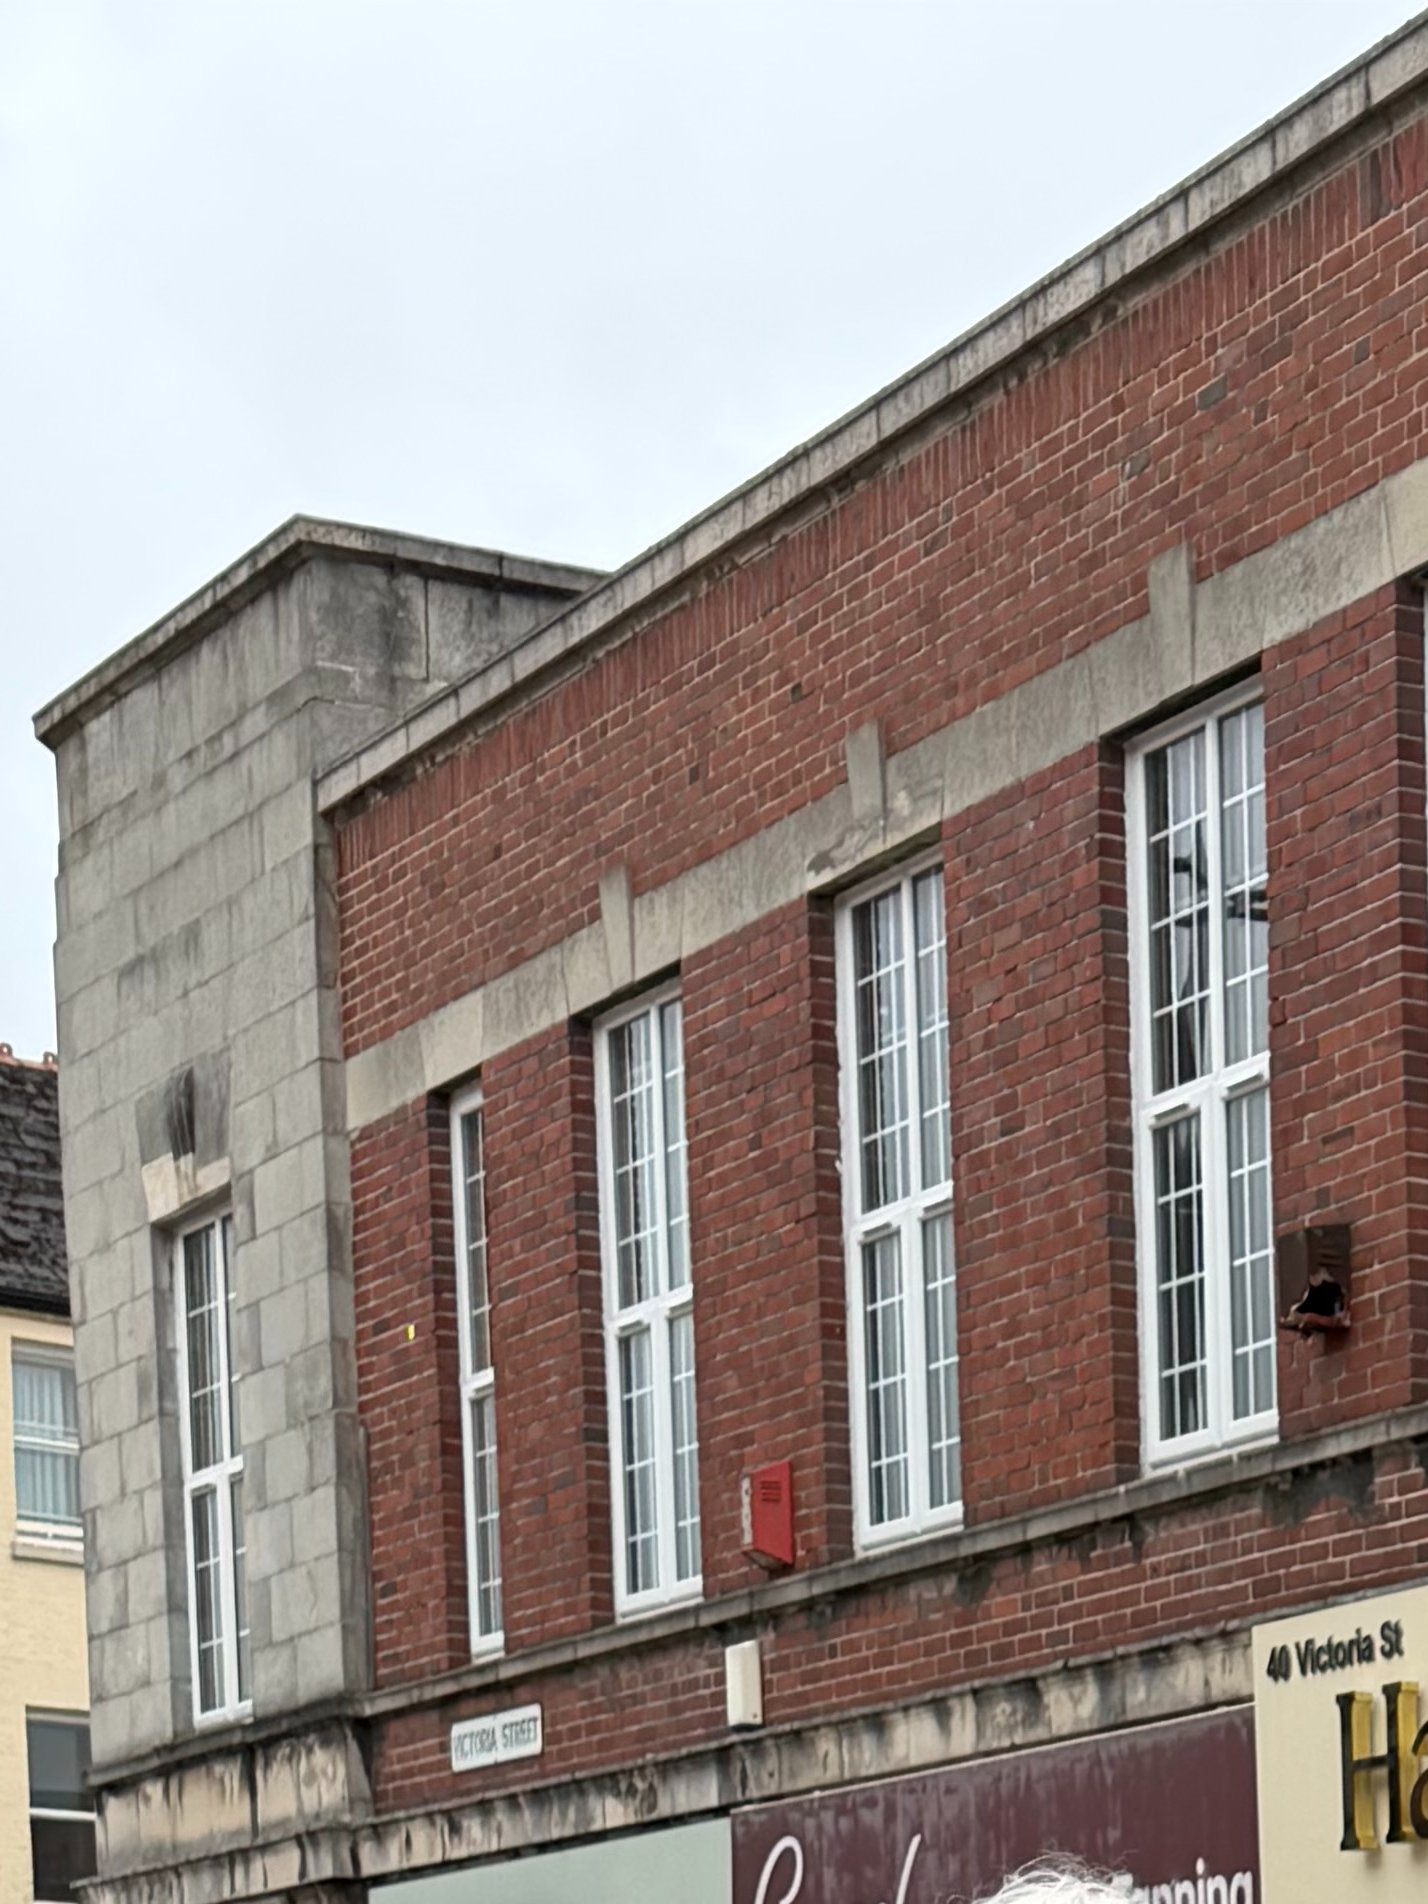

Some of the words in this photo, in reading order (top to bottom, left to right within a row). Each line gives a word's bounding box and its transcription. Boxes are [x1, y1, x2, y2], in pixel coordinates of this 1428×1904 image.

[1266, 1645, 1292, 1683] 40
[1294, 1626, 1376, 1677] Victoria
[1380, 1616, 1404, 1659] St
[454, 1727, 498, 1760] VICTORIA
[502, 1716, 539, 1748] STREET
